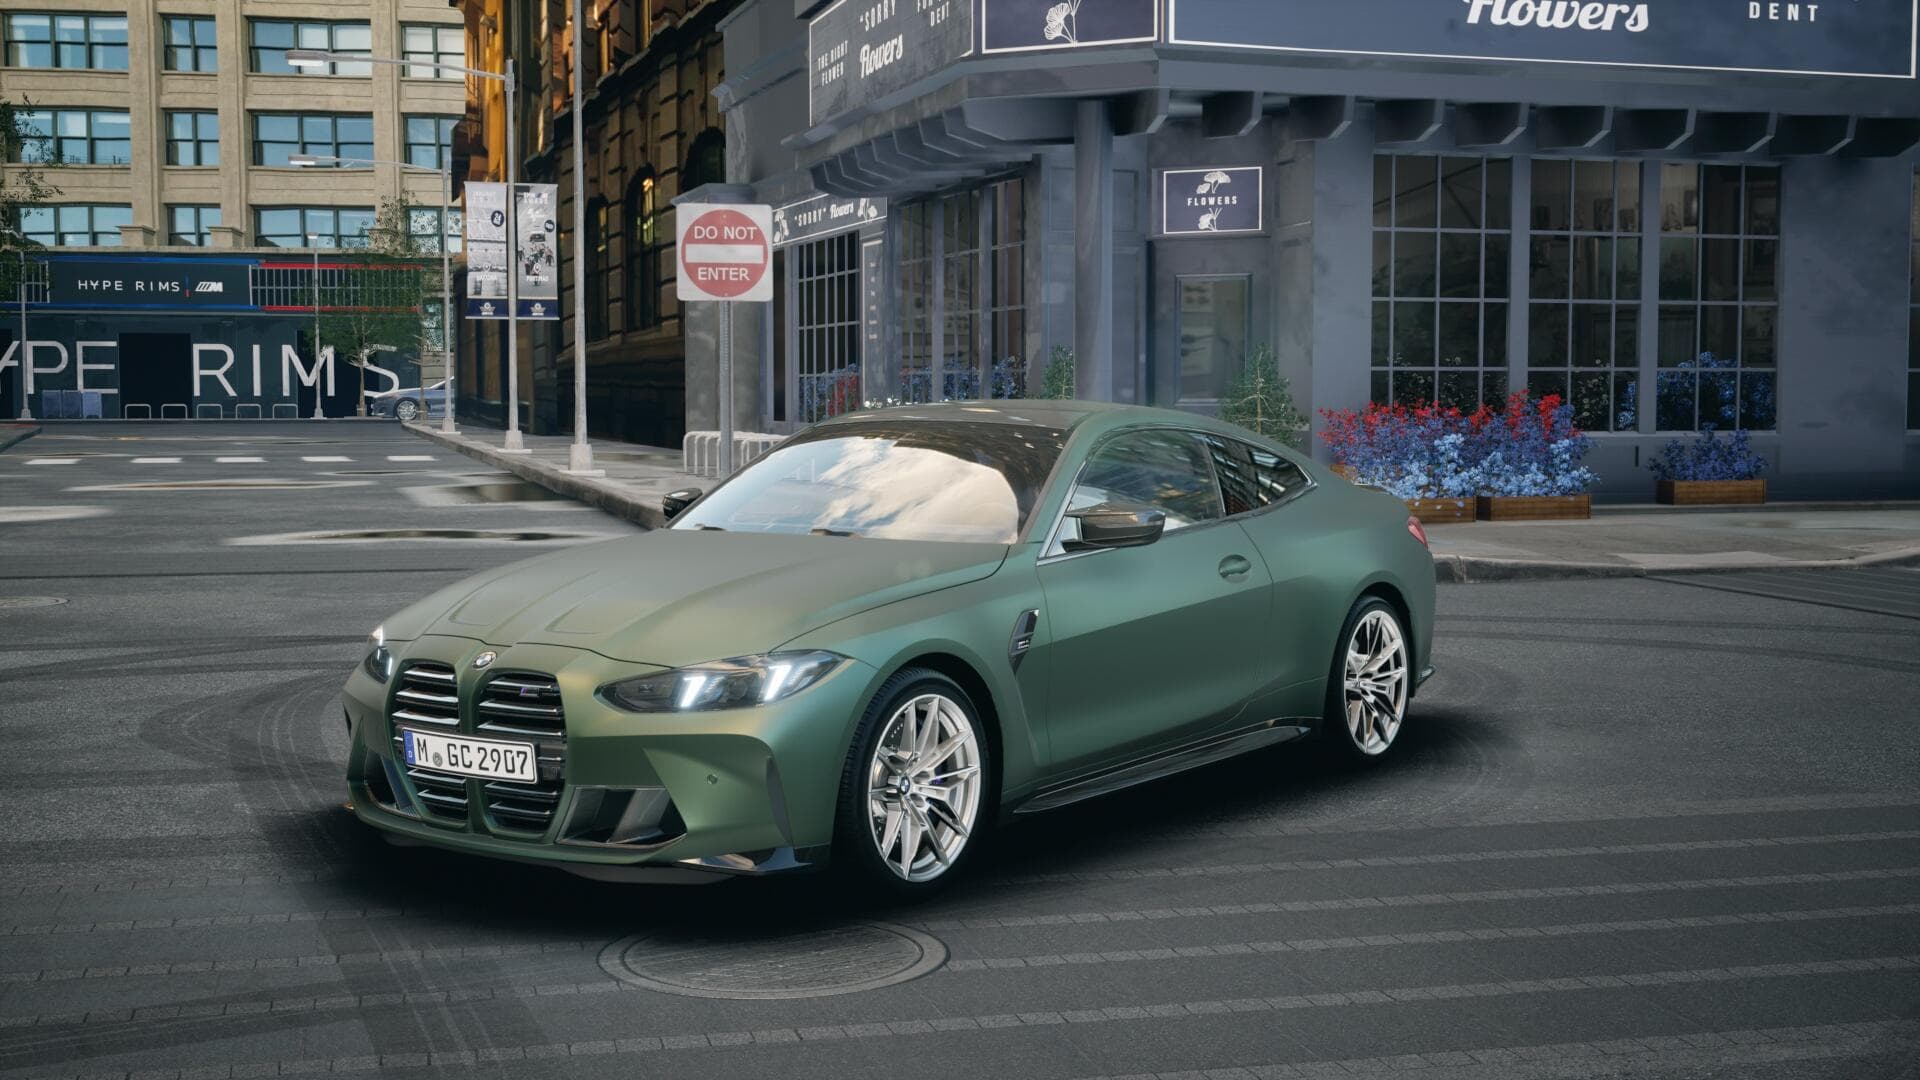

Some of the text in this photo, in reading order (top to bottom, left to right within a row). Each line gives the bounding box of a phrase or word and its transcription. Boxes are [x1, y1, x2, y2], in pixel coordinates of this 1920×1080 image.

[930, 1, 950, 26] DENT
[1748, 1, 1819, 22] DENT
[818, 40, 848, 72] THE RIGHT
[821, 61, 844, 87] FLOWER
[1187, 196, 1238, 207] FLOWERS
[694, 225, 757, 241] DO NOT
[697, 266, 750, 281] ENTER
[78, 279, 123, 291] HYPE
[135, 280, 180, 292] RIMS
[193, 343, 400, 397] RIMS
[416, 737, 527, 775] M GC 2907
